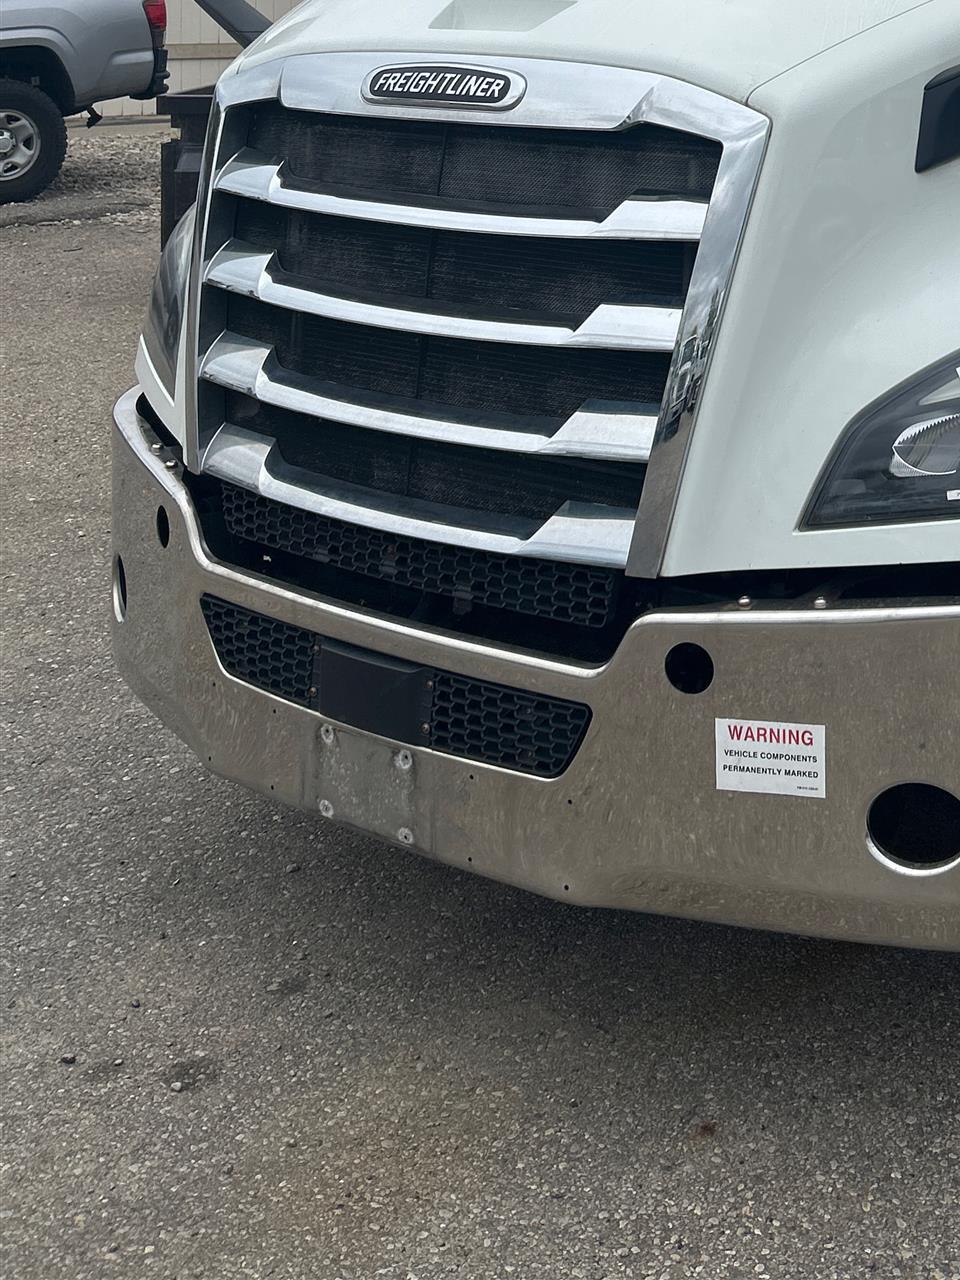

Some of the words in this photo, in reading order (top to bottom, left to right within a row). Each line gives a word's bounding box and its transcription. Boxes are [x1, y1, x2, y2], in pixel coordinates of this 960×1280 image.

[374, 72, 505, 98] FREIGHTLINER
[728, 725, 814, 746] WARNING
[724, 749, 758, 759] VEHICLE
[760, 752, 818, 763] COMPONENTS
[723, 764, 782, 776] PERMANENTLY
[784, 769, 819, 779] MARKED
